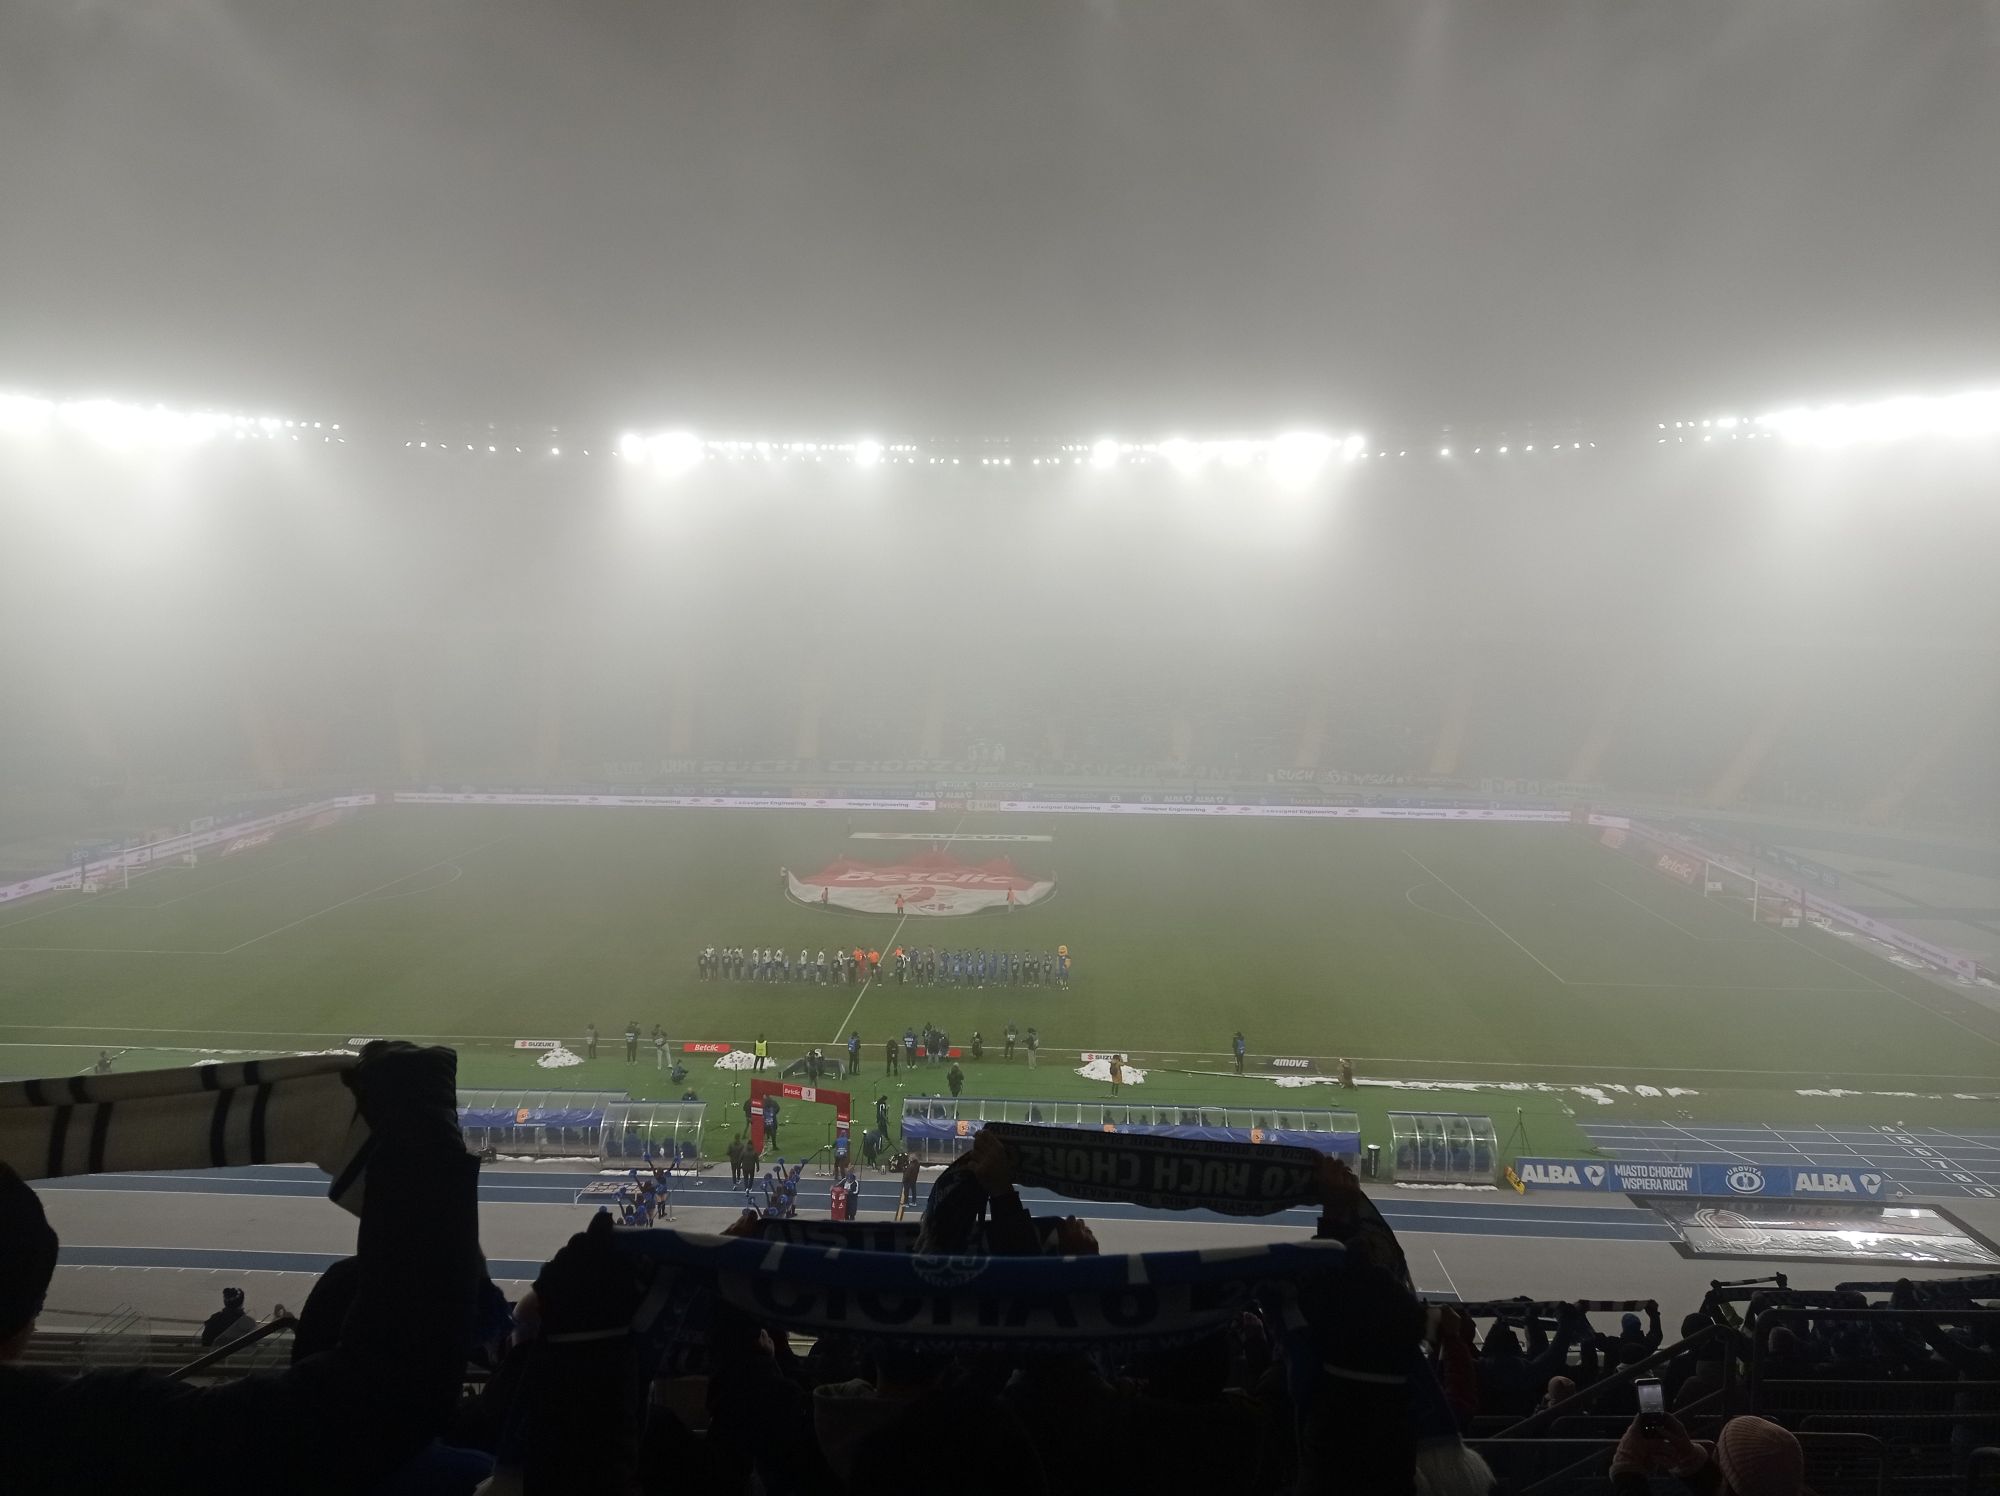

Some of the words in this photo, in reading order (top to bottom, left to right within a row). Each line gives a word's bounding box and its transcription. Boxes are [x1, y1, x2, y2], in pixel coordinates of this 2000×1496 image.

[1658, 855, 1693, 879] Betclic
[834, 871, 1017, 884] Betclic
[694, 1044, 718, 1052] Betclic
[1273, 1058, 1309, 1067] 4MOVE
[1896, 1136, 1914, 1144] 5
[1913, 1147, 1932, 1156] 6
[1010, 1145, 1140, 1186] CHORZ
[1930, 1159, 1948, 1169] 7
[1153, 1156, 1250, 1195] RUCH
[1521, 1164, 1581, 1184] ALBA
[1614, 1164, 1648, 1177] MIASTO
[1649, 1164, 1693, 1178] CHORZÓW
[1727, 1165, 1762, 1176] UROVITA
[1795, 1172, 1856, 1193] ALBA
[1952, 1173, 1973, 1183] 8
[1621, 1179, 1662, 1190] WSPIERA
[1662, 1179, 1688, 1191] RUCH
[1974, 1187, 1996, 1198] 9
